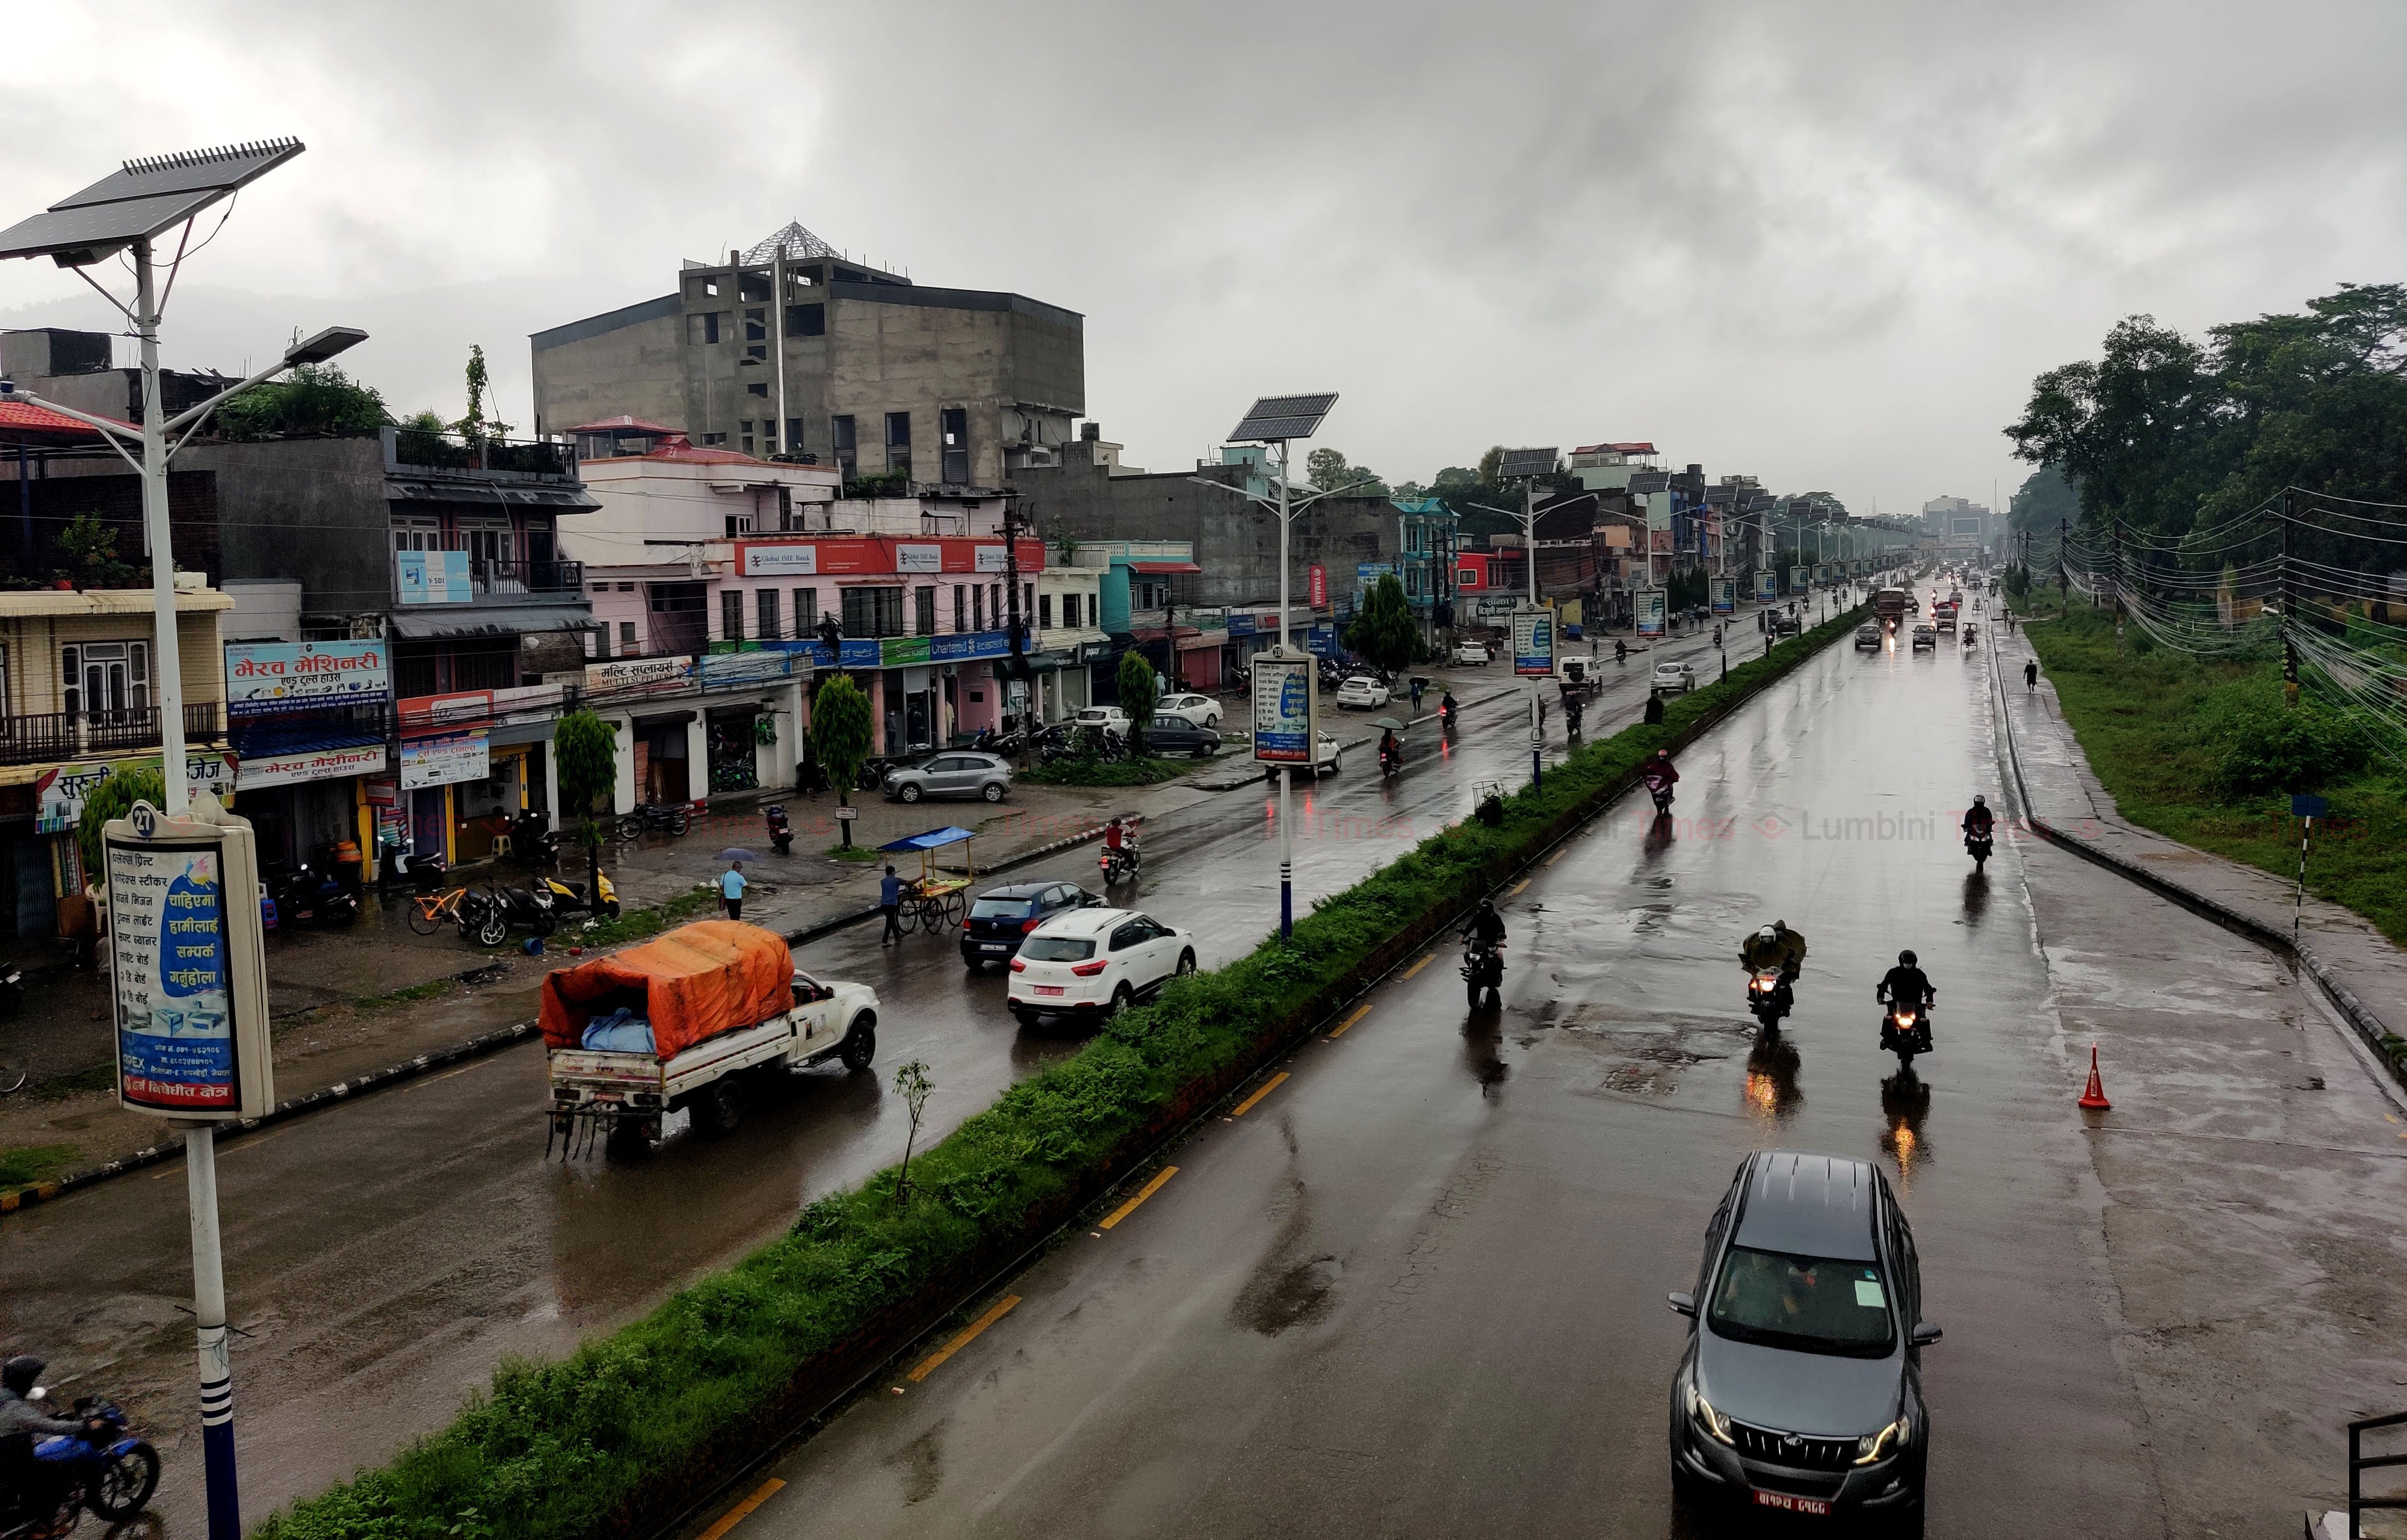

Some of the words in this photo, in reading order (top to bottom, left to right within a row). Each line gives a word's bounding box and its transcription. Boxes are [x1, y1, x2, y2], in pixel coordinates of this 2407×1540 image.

[1496, 607, 1512, 615] भण्डा
[897, 644, 930, 657] Standard
[932, 640, 966, 655] Chartered
[235, 658, 286, 677] भैरव
[294, 651, 379, 673] मेशिनरी
[601, 665, 629, 678] मल्टि
[630, 660, 674, 676] सप्लायर्स
[280, 676, 297, 686] एण्ड
[300, 675, 318, 686] टुल्स
[318, 673, 341, 684] हाउस
[602, 677, 628, 686] MULTI
[631, 672, 674, 684] SUPPLIERS
[265, 762, 306, 774] भैरव
[311, 750, 377, 767] मेशीनरी
[134, 810, 150, 830] 27
[135, 853, 154, 867] प्रिन्ट
[138, 873, 168, 887] स्टीकर
[131, 893, 153, 906] भिजन
[168, 891, 216, 909] चाहिएमा
[117, 912, 131, 925] ट्रान्स
[133, 914, 153, 926] लाईट
[168, 917, 218, 935] हामीलाई
[119, 951, 134, 963] लाईट
[136, 952, 149, 965] बोर्ड
[175, 943, 215, 959] सम्पर्क
[134, 971, 147, 985] बोर्ड
[168, 967, 217, 988] गर्नुहोला
[135, 992, 149, 1004] बोर्ड
[122, 1053, 146, 1069] APEX
[211, 1069, 230, 1077] नेपाल
[149, 1081, 196, 1097] निषेधीत
[199, 1084, 230, 1098] क्षेत्र
